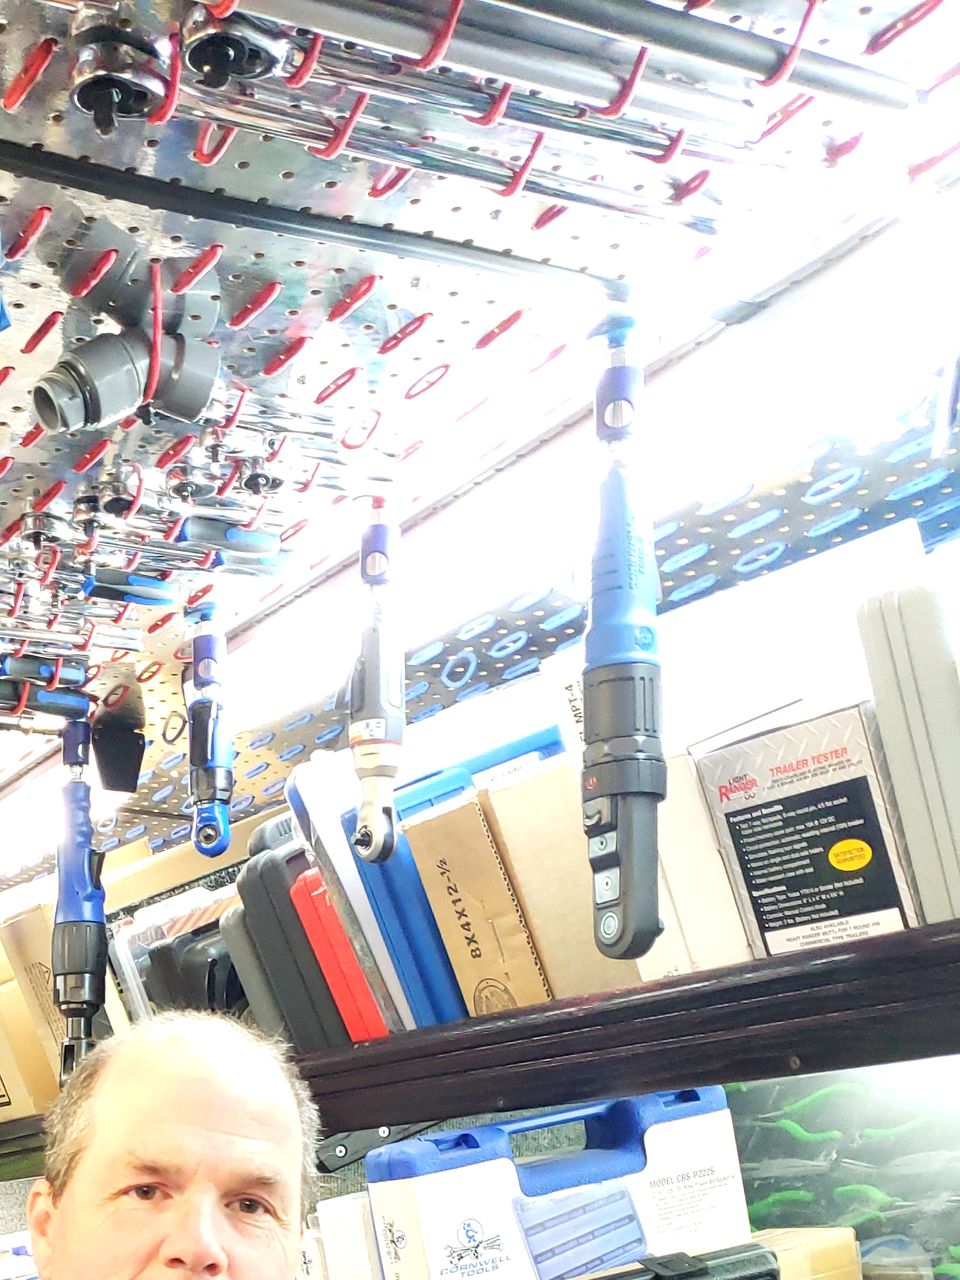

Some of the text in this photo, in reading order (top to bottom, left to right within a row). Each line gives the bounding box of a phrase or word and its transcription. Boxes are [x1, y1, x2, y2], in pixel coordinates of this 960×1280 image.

[769, 747, 848, 777] TRAILER TESTER
[728, 773, 748, 785] LIGHT
[717, 779, 758, 803] RANGER
[649, 1176, 674, 1188] MODEL
[440, 1255, 511, 1276] CORNWELL
[460, 1264, 499, 1278] TOOLS
